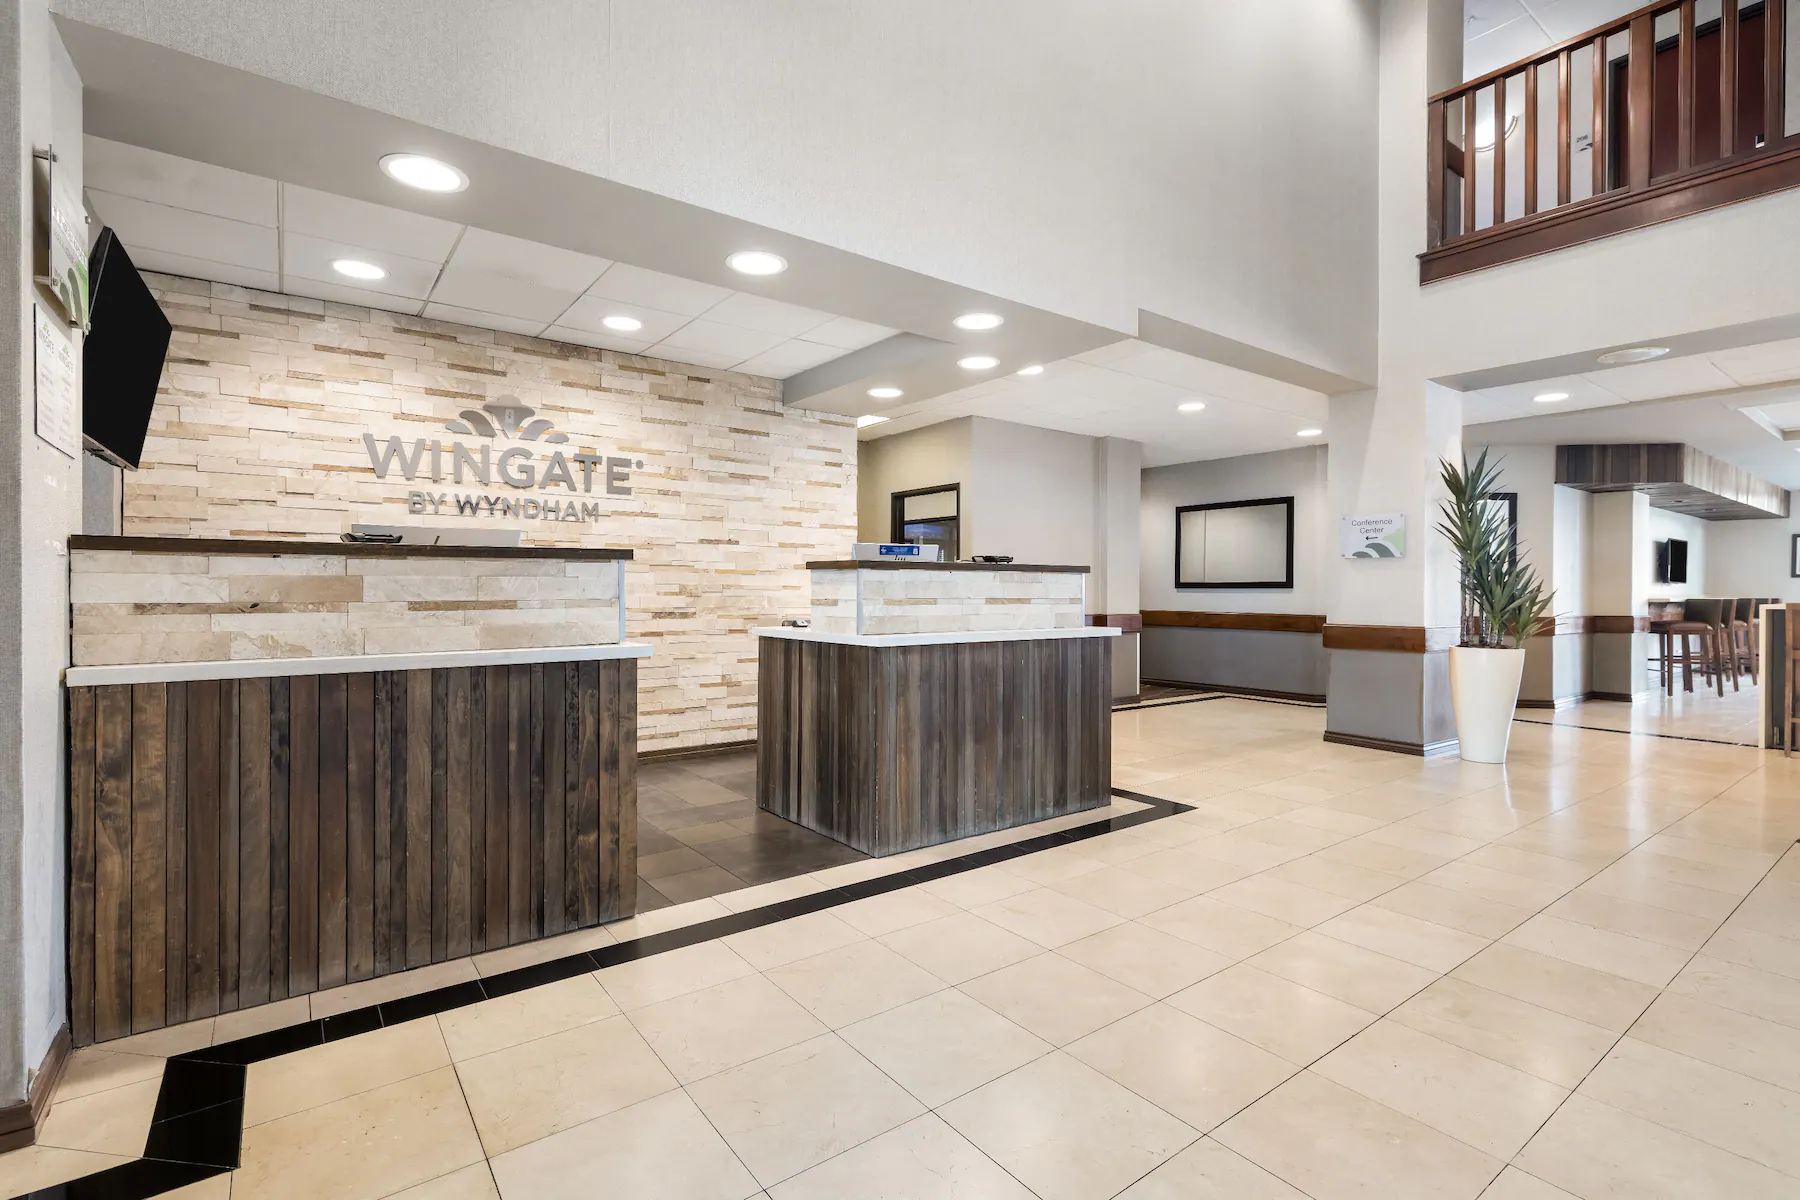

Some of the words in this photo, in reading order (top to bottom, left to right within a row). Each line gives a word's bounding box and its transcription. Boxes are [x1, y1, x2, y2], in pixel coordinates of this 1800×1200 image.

[363, 432, 632, 496] WINGATE
[408, 490, 447, 515] BY
[454, 493, 599, 523] WYNDHAM
[1351, 518, 1393, 527] Conference
